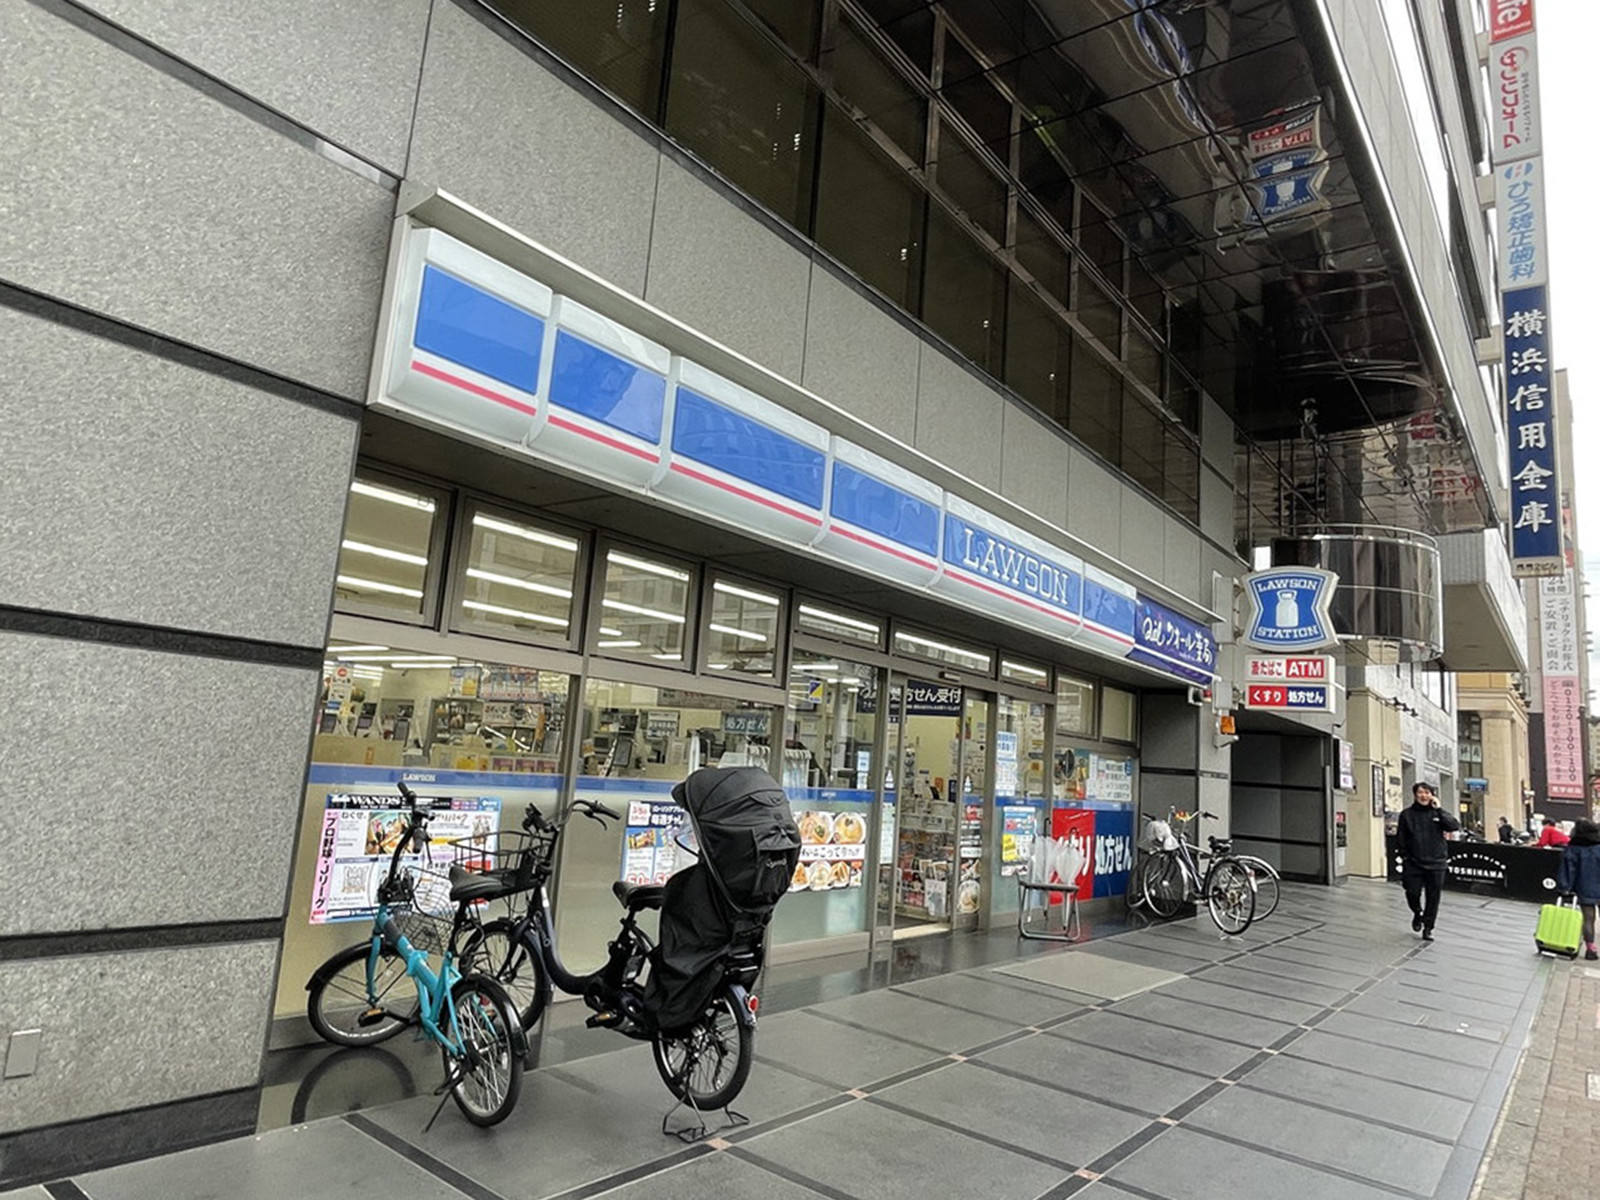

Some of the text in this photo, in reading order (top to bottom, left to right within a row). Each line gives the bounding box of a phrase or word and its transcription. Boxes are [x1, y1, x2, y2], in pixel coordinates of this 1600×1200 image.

[1506, 180, 1535, 282] ひろ矯正歯科
[1506, 309, 1553, 533] 横浜信用金庫
[963, 529, 1068, 604] LAWSON
[1257, 578, 1318, 592] LAWSON
[1257, 625, 1319, 639] STATION
[1288, 660, 1322, 676] ATM
[1253, 690, 1324, 704] くすり 処方せん
[403, 773, 437, 782] LAWSON
[351, 795, 401, 805] WANDS
[315, 817, 336, 909] プロ野球・Jリーグ
[1095, 834, 1133, 876] 処方せん
